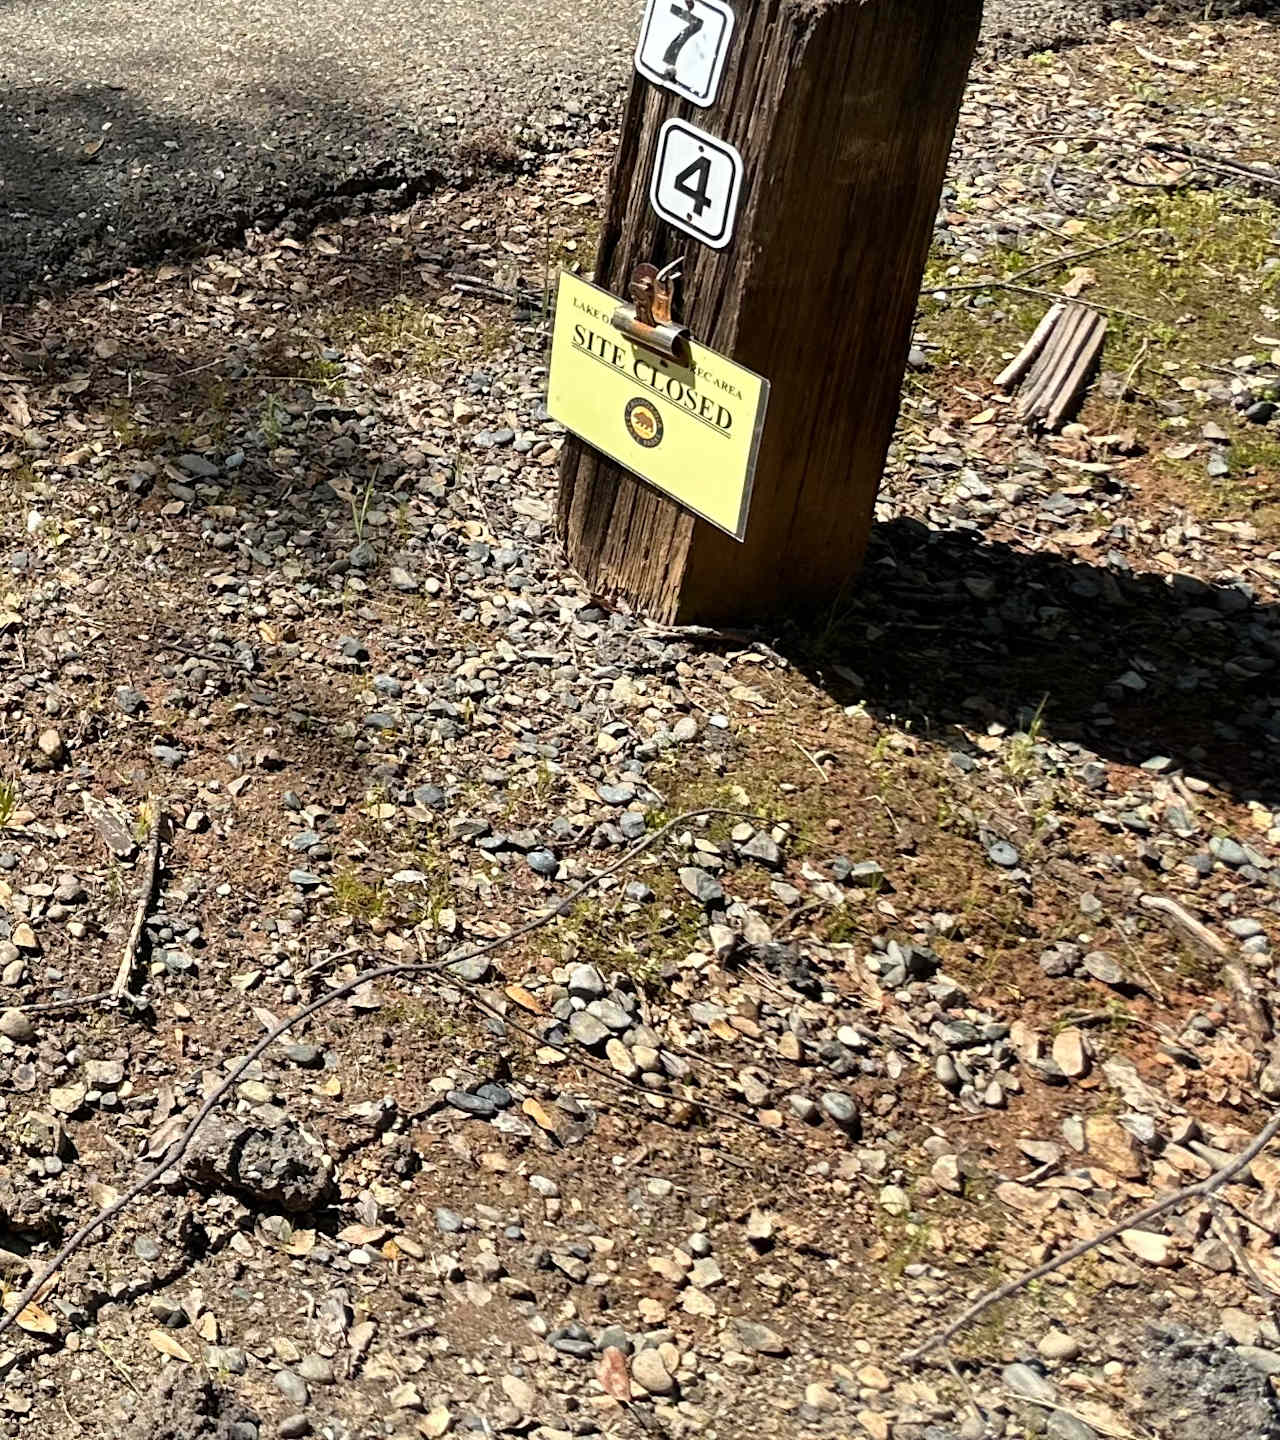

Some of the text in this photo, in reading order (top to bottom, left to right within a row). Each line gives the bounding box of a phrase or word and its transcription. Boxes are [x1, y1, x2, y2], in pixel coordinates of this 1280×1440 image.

[662, 3, 705, 66] 7
[673, 155, 713, 217] 4
[572, 296, 601, 320] LAKE
[713, 378, 743, 401] AREA
[572, 323, 627, 370] SITE
[633, 359, 733, 429] CLOSED
